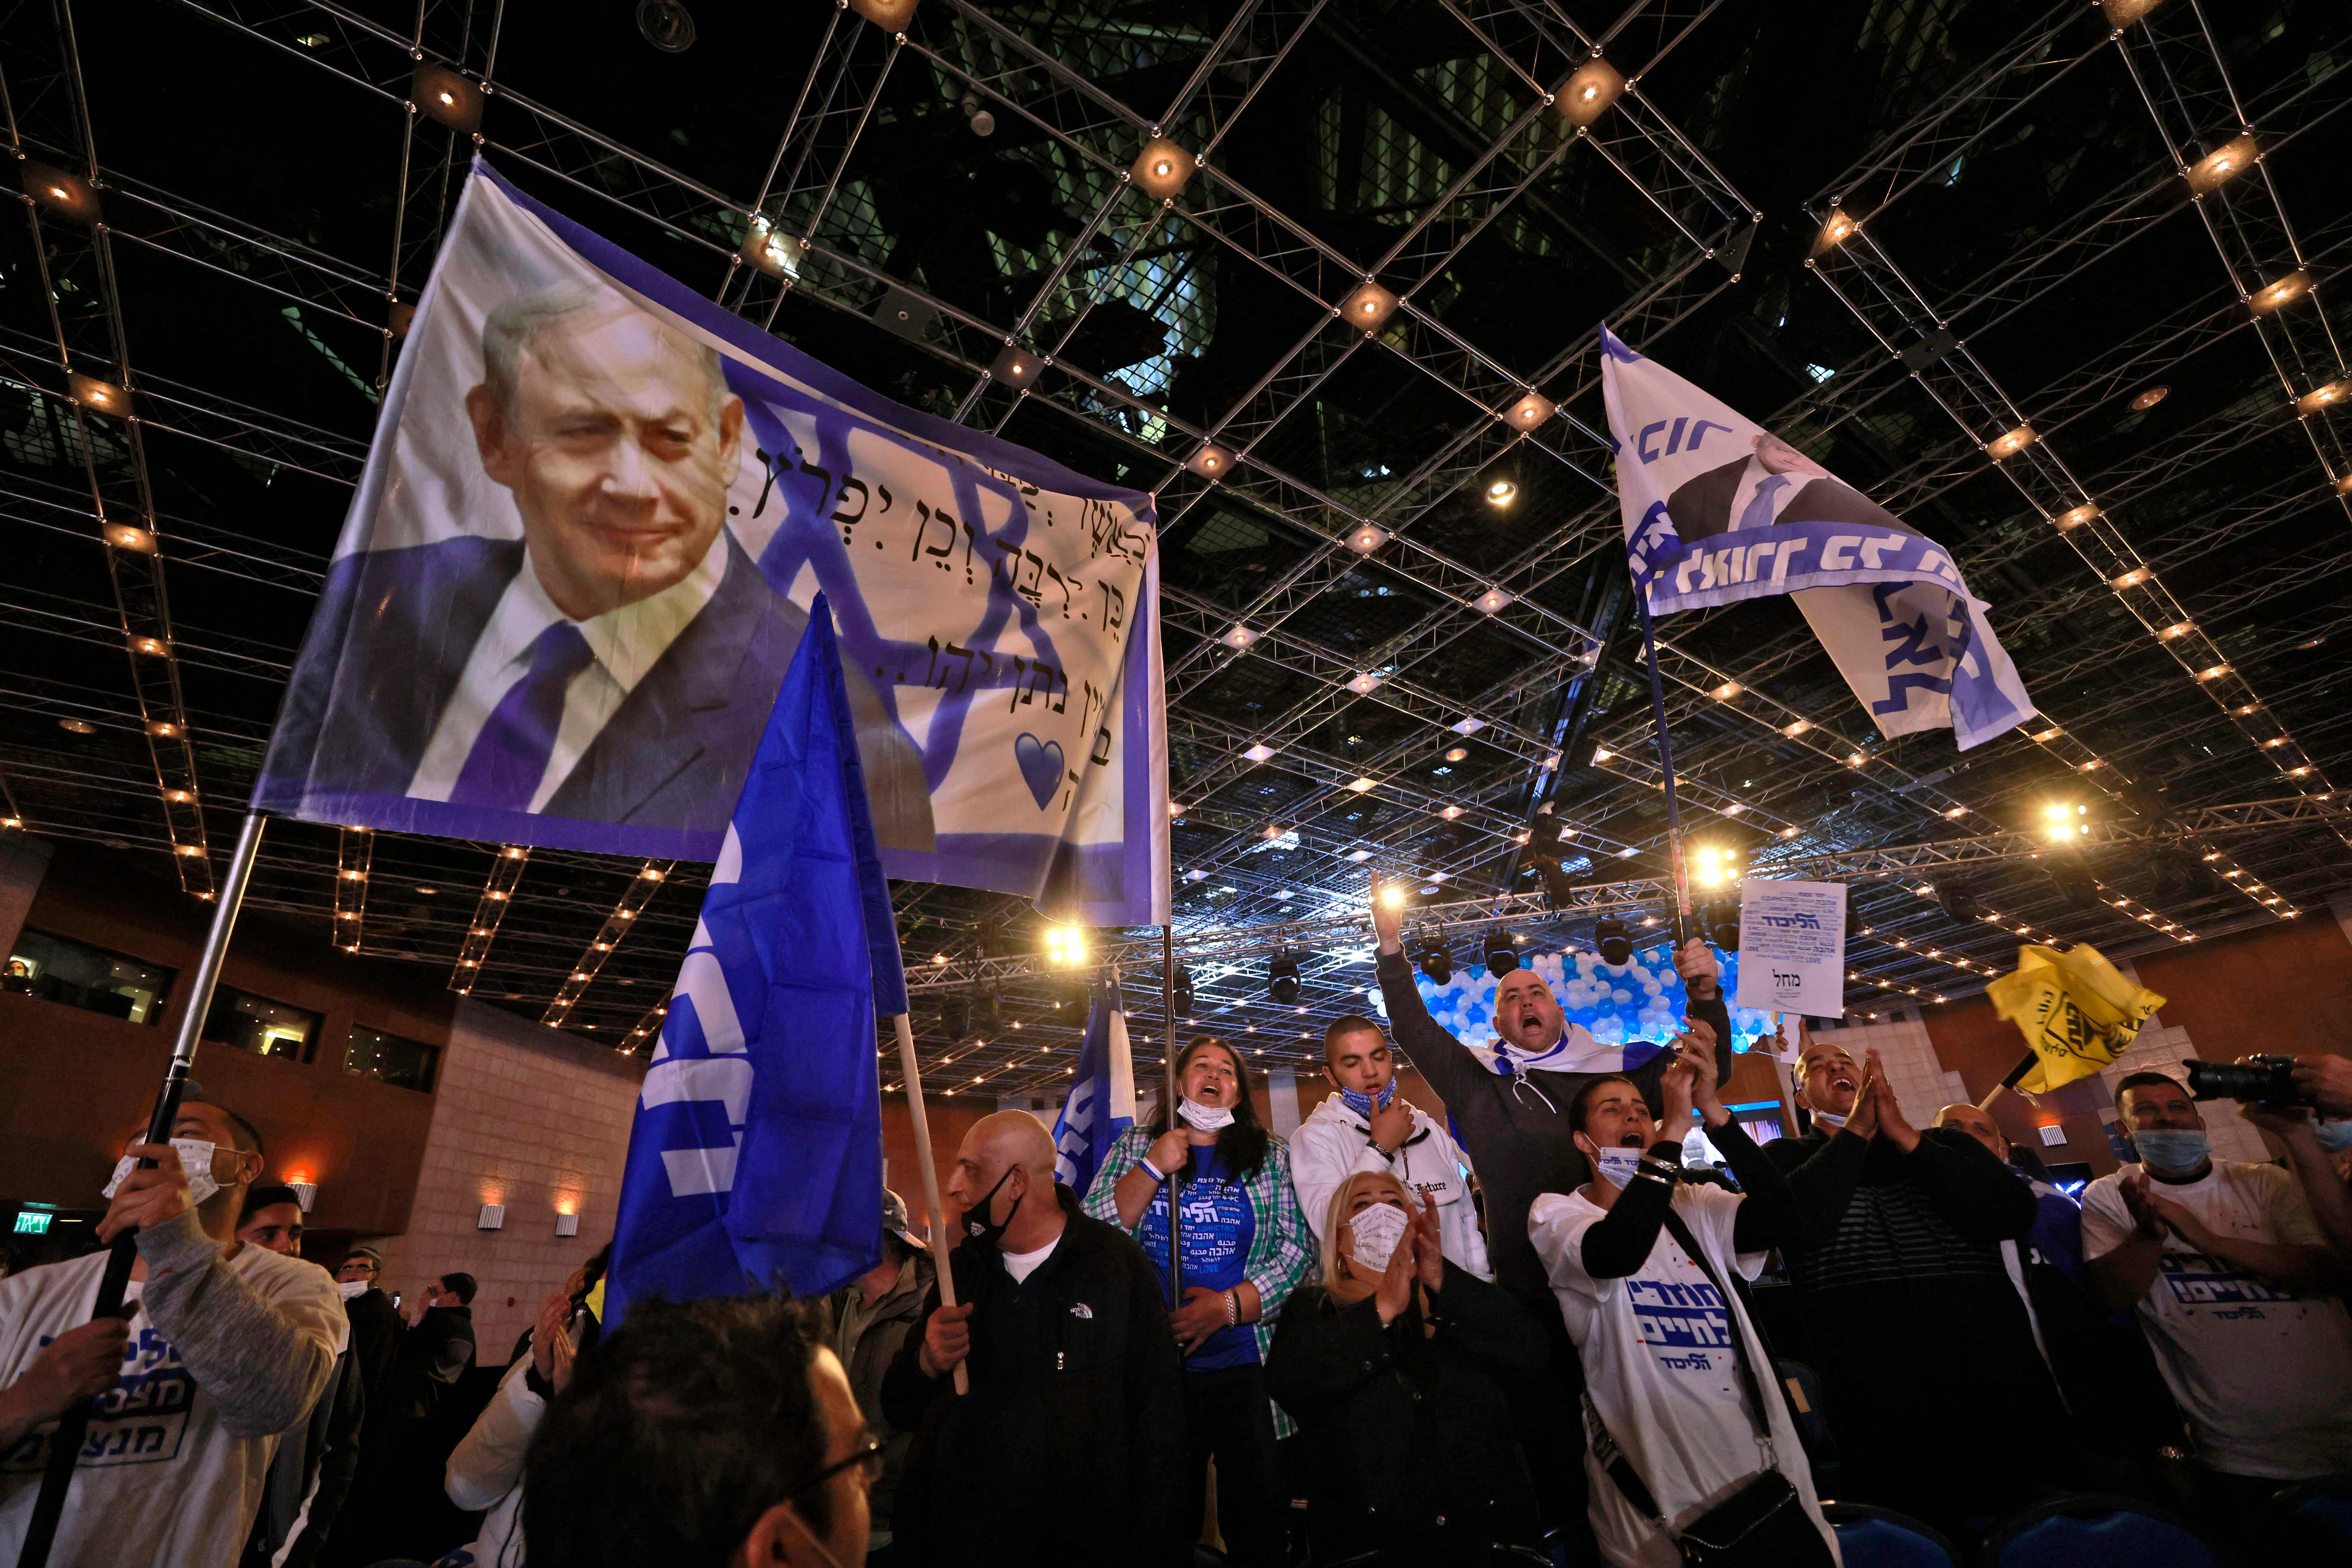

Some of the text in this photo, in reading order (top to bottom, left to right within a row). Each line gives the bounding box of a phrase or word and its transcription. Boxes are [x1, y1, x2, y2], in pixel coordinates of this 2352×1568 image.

[1762, 913, 1821, 930] הליכוד
[1772, 969, 1800, 987] מחל
[14, 1214, 51, 1233] יציאה
[1209, 1247, 1236, 1256] אהבה
[1199, 1264, 1219, 1274] LOVE
[1625, 1277, 1725, 1307] חוזרי
[1636, 1312, 1732, 1344] לחיים
[1660, 1353, 1712, 1370] הליכוד
